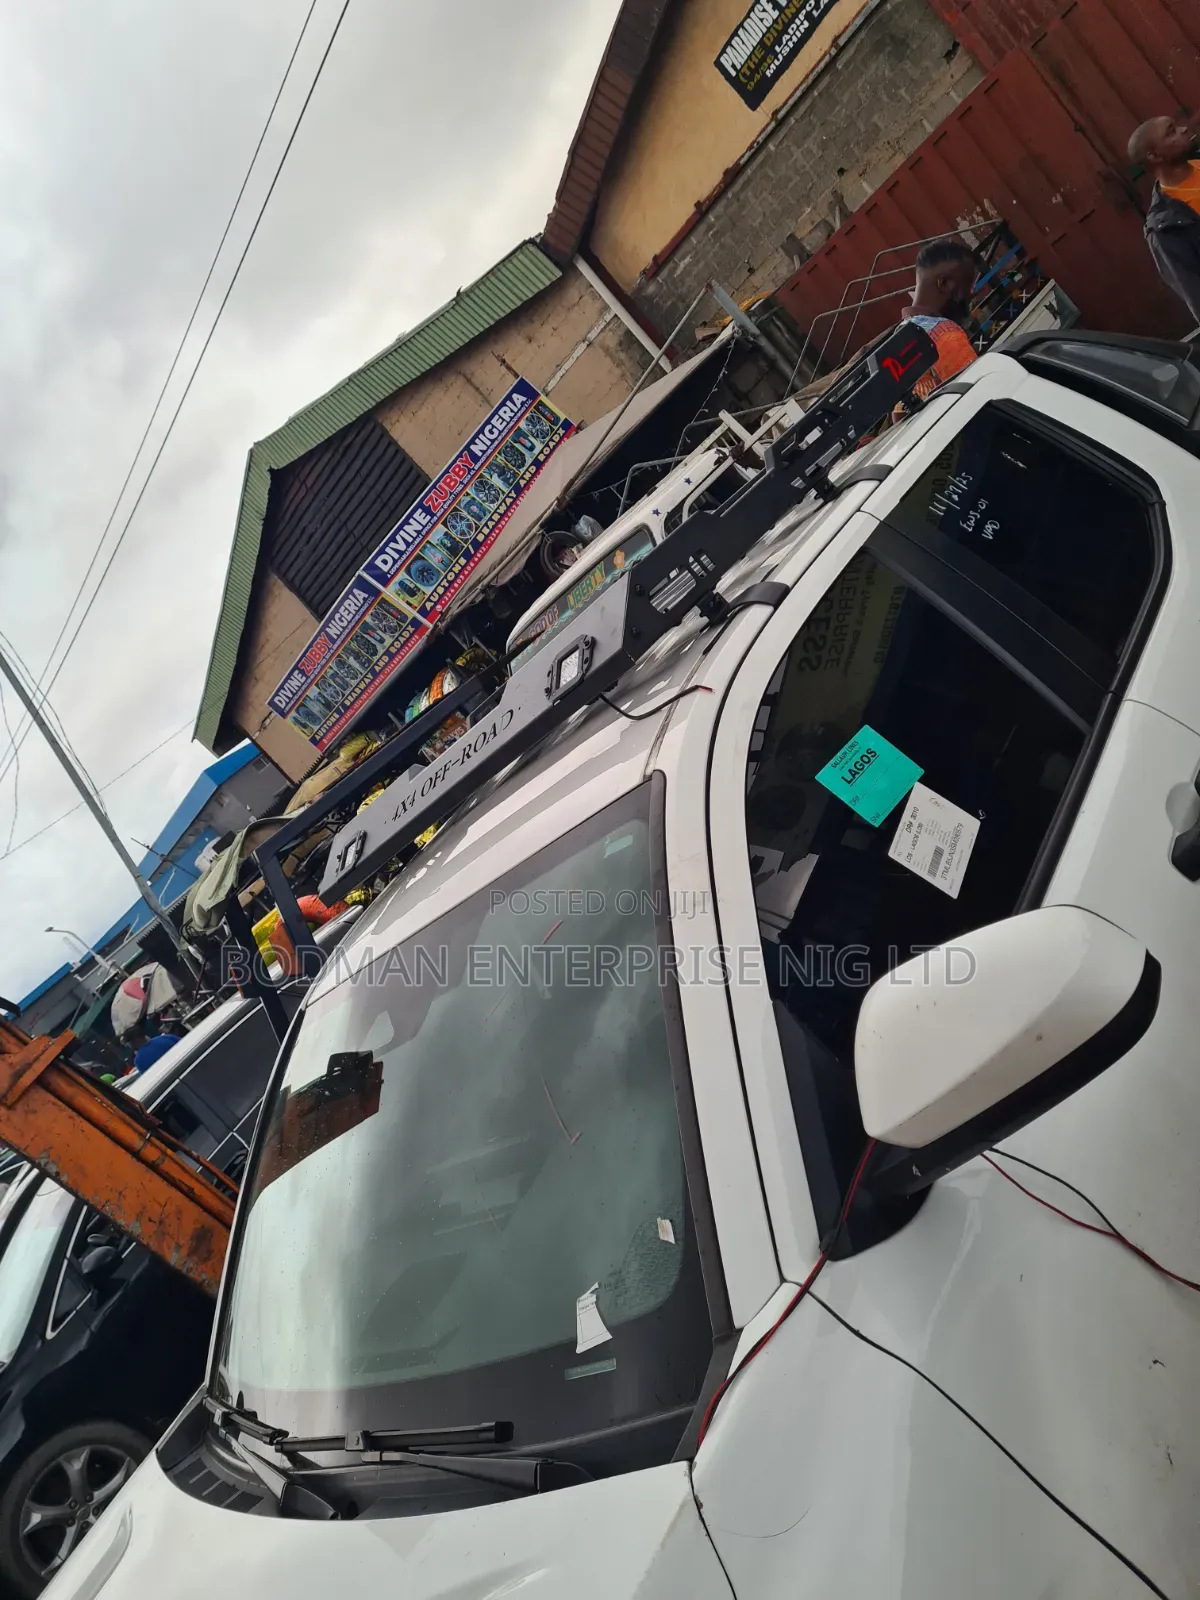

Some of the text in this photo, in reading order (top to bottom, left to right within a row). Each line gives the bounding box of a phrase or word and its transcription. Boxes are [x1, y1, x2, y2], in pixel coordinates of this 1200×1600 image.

[720, 0, 779, 77] PARADISE
[739, 45, 765, 83] (THE
[765, 20, 809, 78] MUSHIN
[774, 0, 815, 53] LADIPO
[374, 508, 431, 573] DIVINE
[423, 451, 474, 513] ZUBBY
[470, 392, 528, 457] NIGERIA
[425, 556, 467, 611] AUSTONE
[476, 490, 517, 542] BEARWAY
[519, 465, 537, 488] AND
[537, 427, 566, 462] ROADX
[567, 561, 606, 612] LIBERTY
[274, 587, 369, 709] DIVINE ZUBBY NIGERIA
[314, 712, 340, 741] AUSTONE
[343, 672, 373, 706] BEARWAY
[374, 655, 389, 672] AND
[389, 625, 415, 654] ROADX
[420, 709, 514, 798] OFF-ROAD
[841, 747, 878, 785] LAGOS
